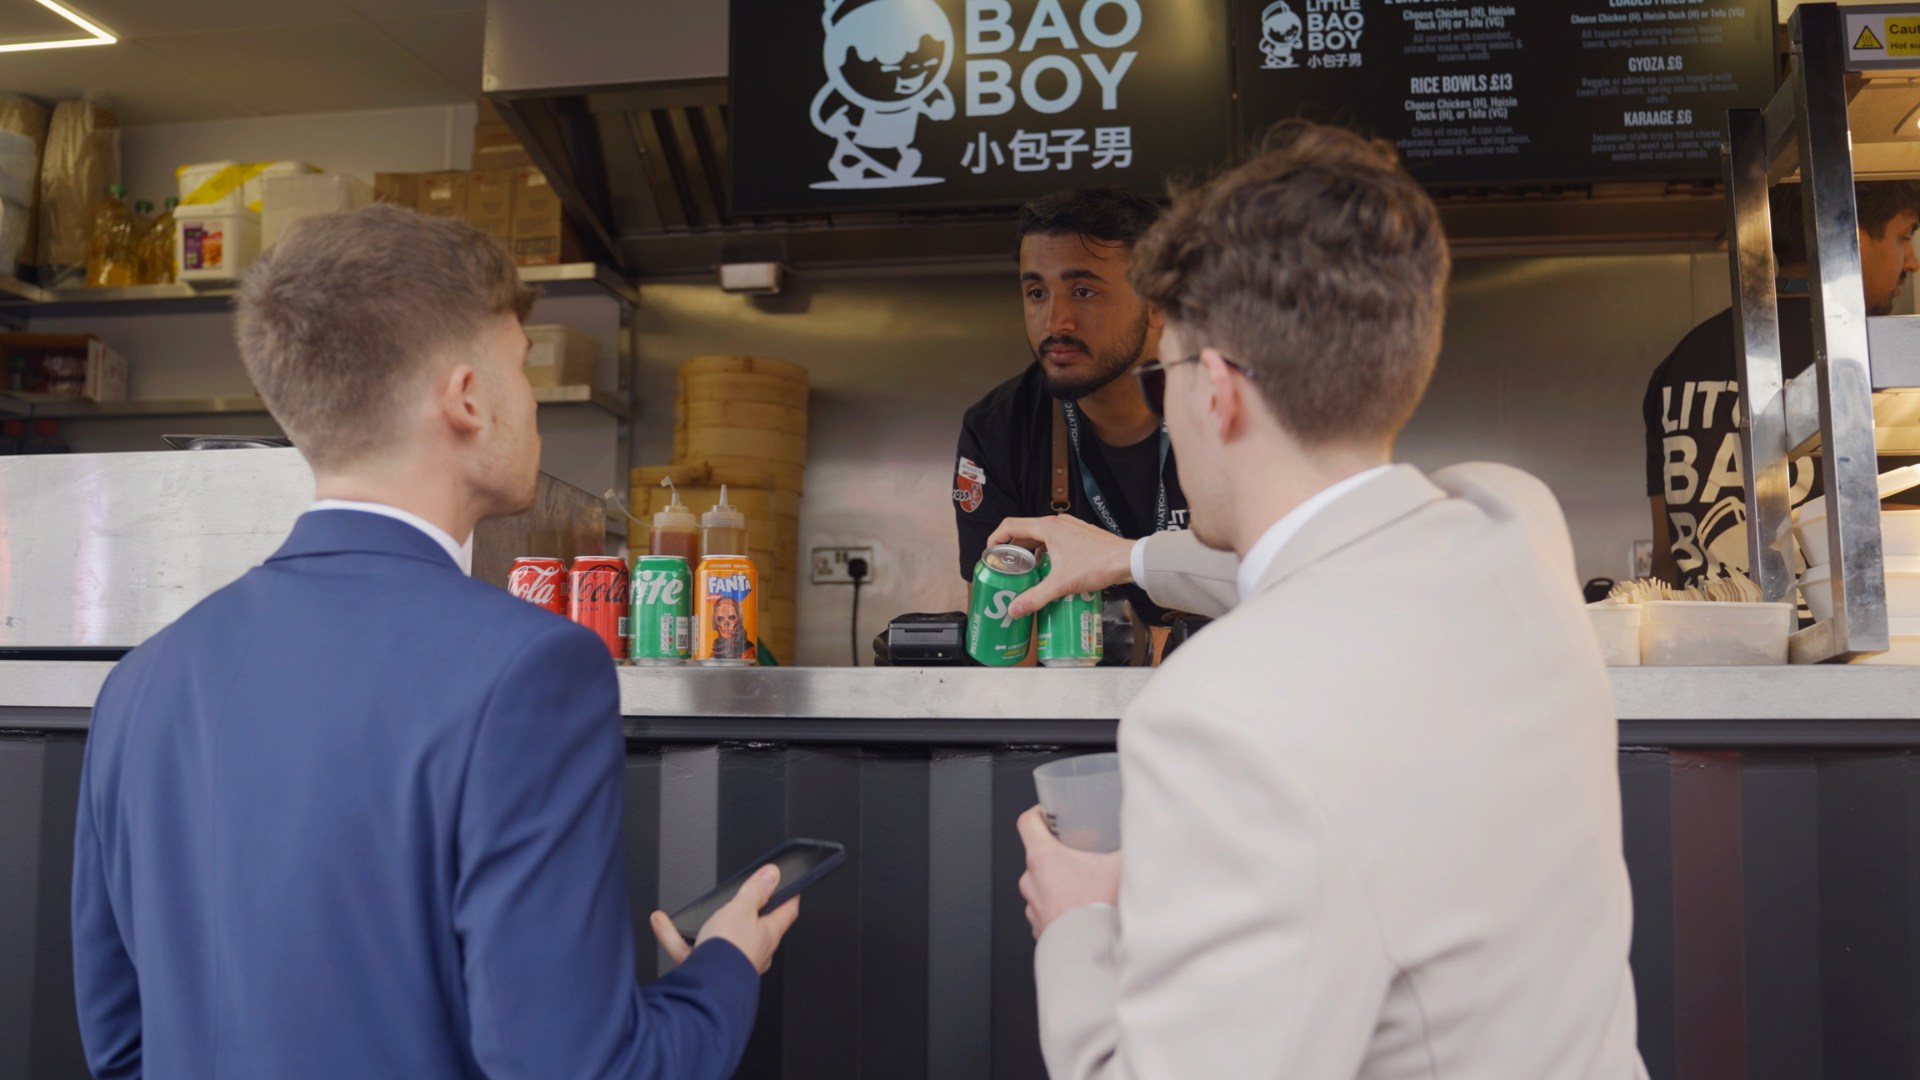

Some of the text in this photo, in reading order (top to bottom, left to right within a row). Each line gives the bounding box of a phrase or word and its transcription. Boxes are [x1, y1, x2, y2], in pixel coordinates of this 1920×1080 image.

[1306, 0, 1361, 12] LITTLE
[1402, 10, 1433, 20] Choose
[1435, 8, 1469, 18] Chicken
[1488, 6, 1515, 16] Hoisin
[965, 0, 1142, 55] BAO
[1307, 11, 1364, 31] BAO
[1414, 20, 1436, 31] Duck
[1453, 20, 1462, 29] or
[1465, 18, 1483, 28] Tofu
[1485, 17, 1504, 29] (VG)
[1308, 30, 1363, 51] BOY
[1890, 41, 1907, 50] Hot
[1628, 55, 1683, 72] GYOZA £6
[965, 51, 1138, 117] BOY
[1410, 73, 1513, 94] RICE BOWLS £13
[1404, 100, 1436, 111] Choose
[1437, 98, 1471, 109] Chicken
[1490, 96, 1518, 107] Hoisin
[1415, 110, 1437, 121] Duck
[1456, 110, 1466, 119] or
[1468, 108, 1486, 119] Tofu
[1488, 107, 1508, 120] (VG)
[1623, 109, 1693, 127] KARAAGE £6
[959, 126, 1134, 175] 小包子男
[1092, 495, 1119, 531] RANDOX
[708, 575, 752, 594] FANTA
